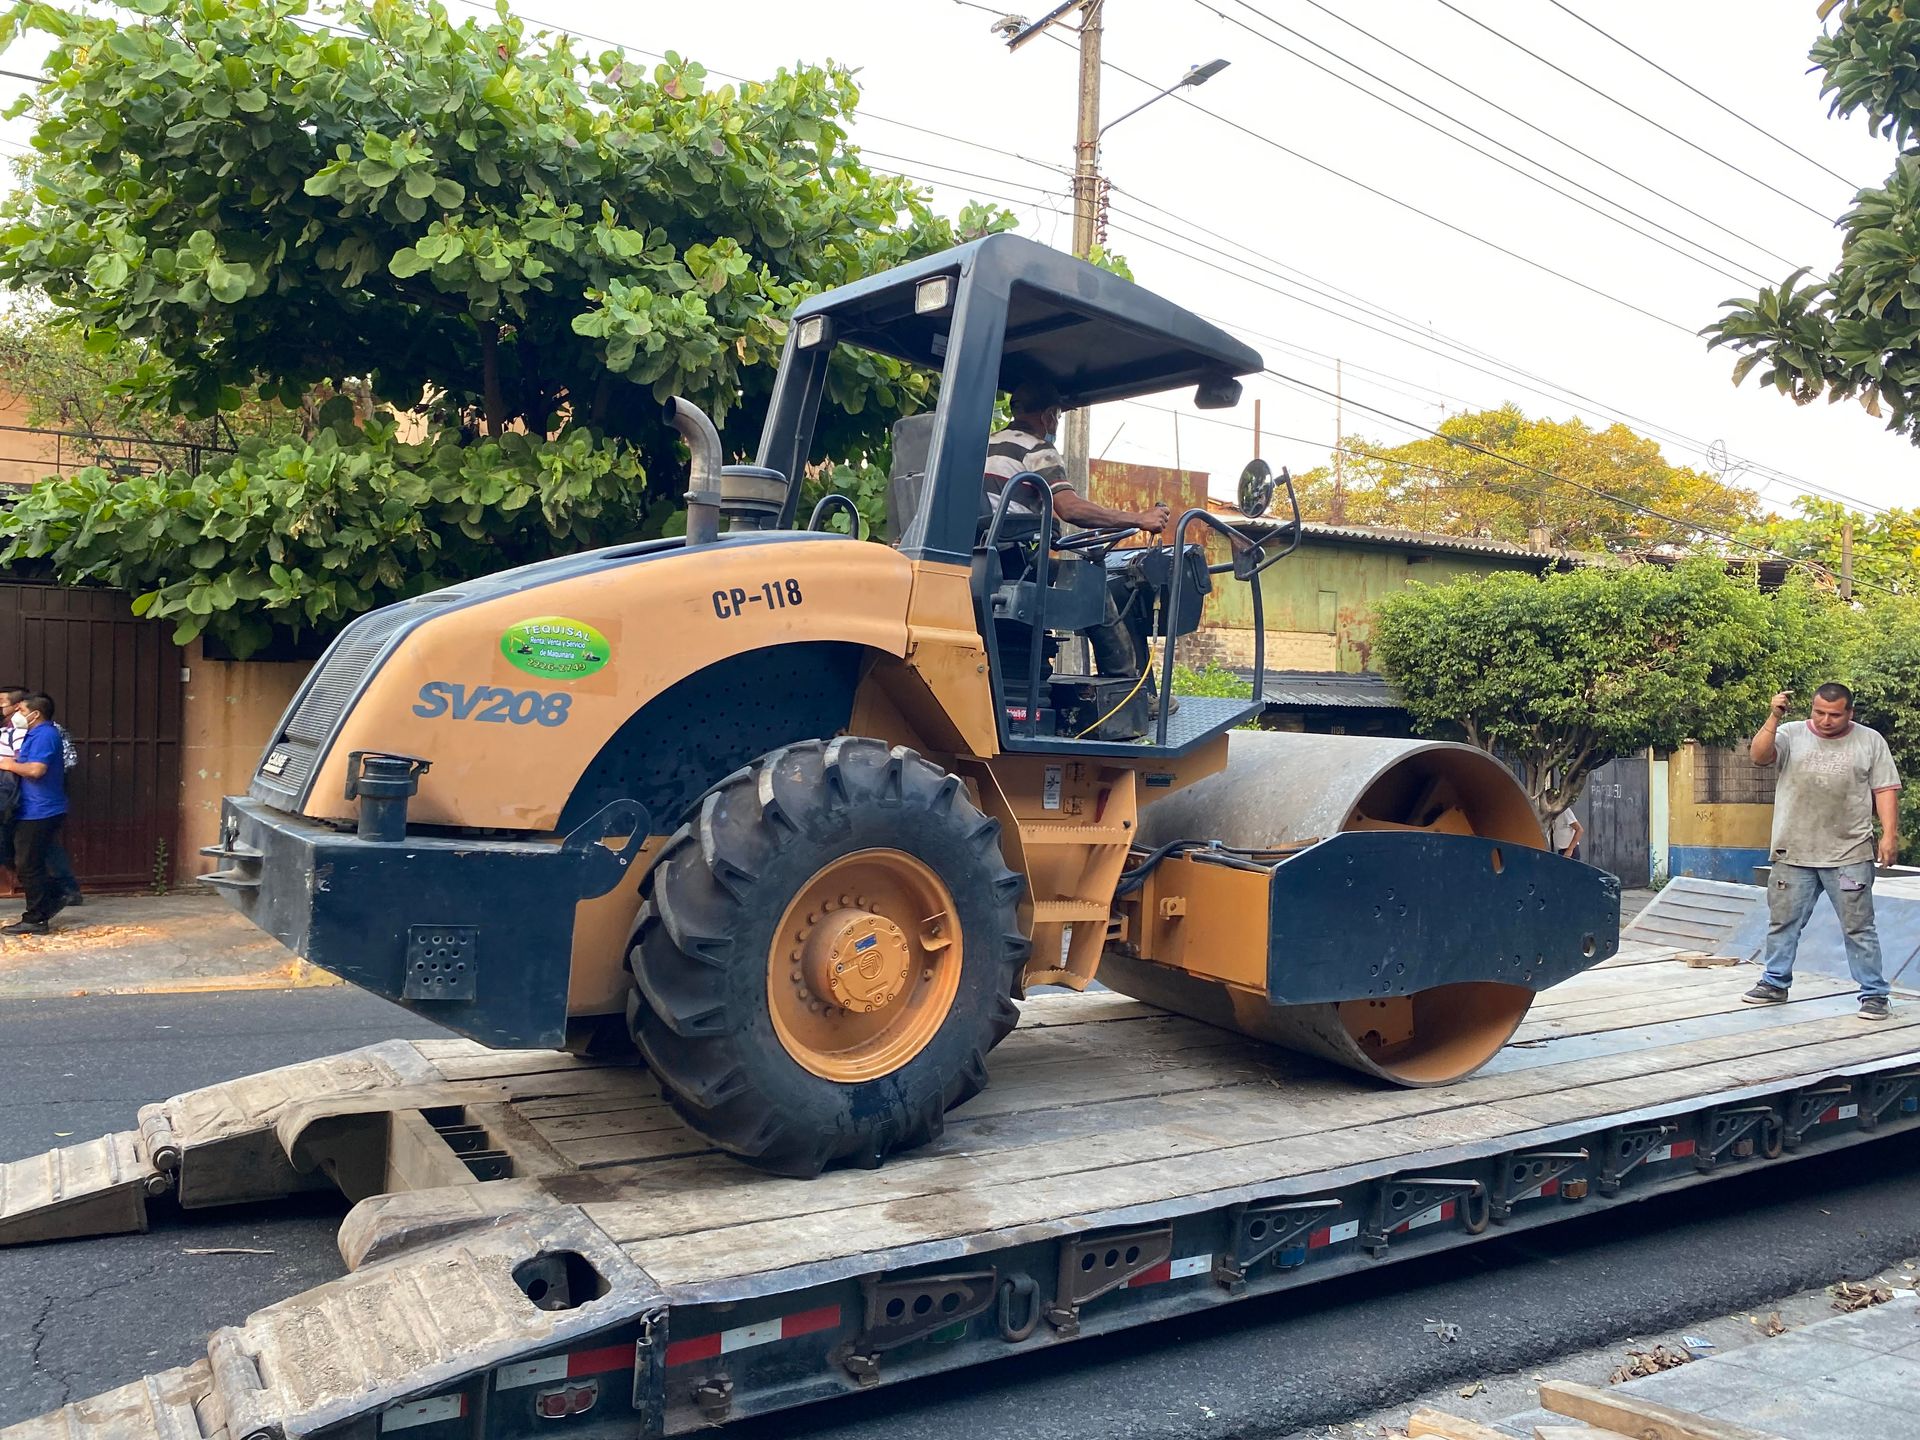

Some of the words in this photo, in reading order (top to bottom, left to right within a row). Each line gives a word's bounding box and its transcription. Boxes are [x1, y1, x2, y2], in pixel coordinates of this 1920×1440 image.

[712, 579, 803, 619] CP-118
[523, 624, 591, 642] TEQUISAL
[566, 640, 586, 649] Servicio
[547, 649, 575, 659] Maquinaria
[412, 681, 573, 728] SV208
